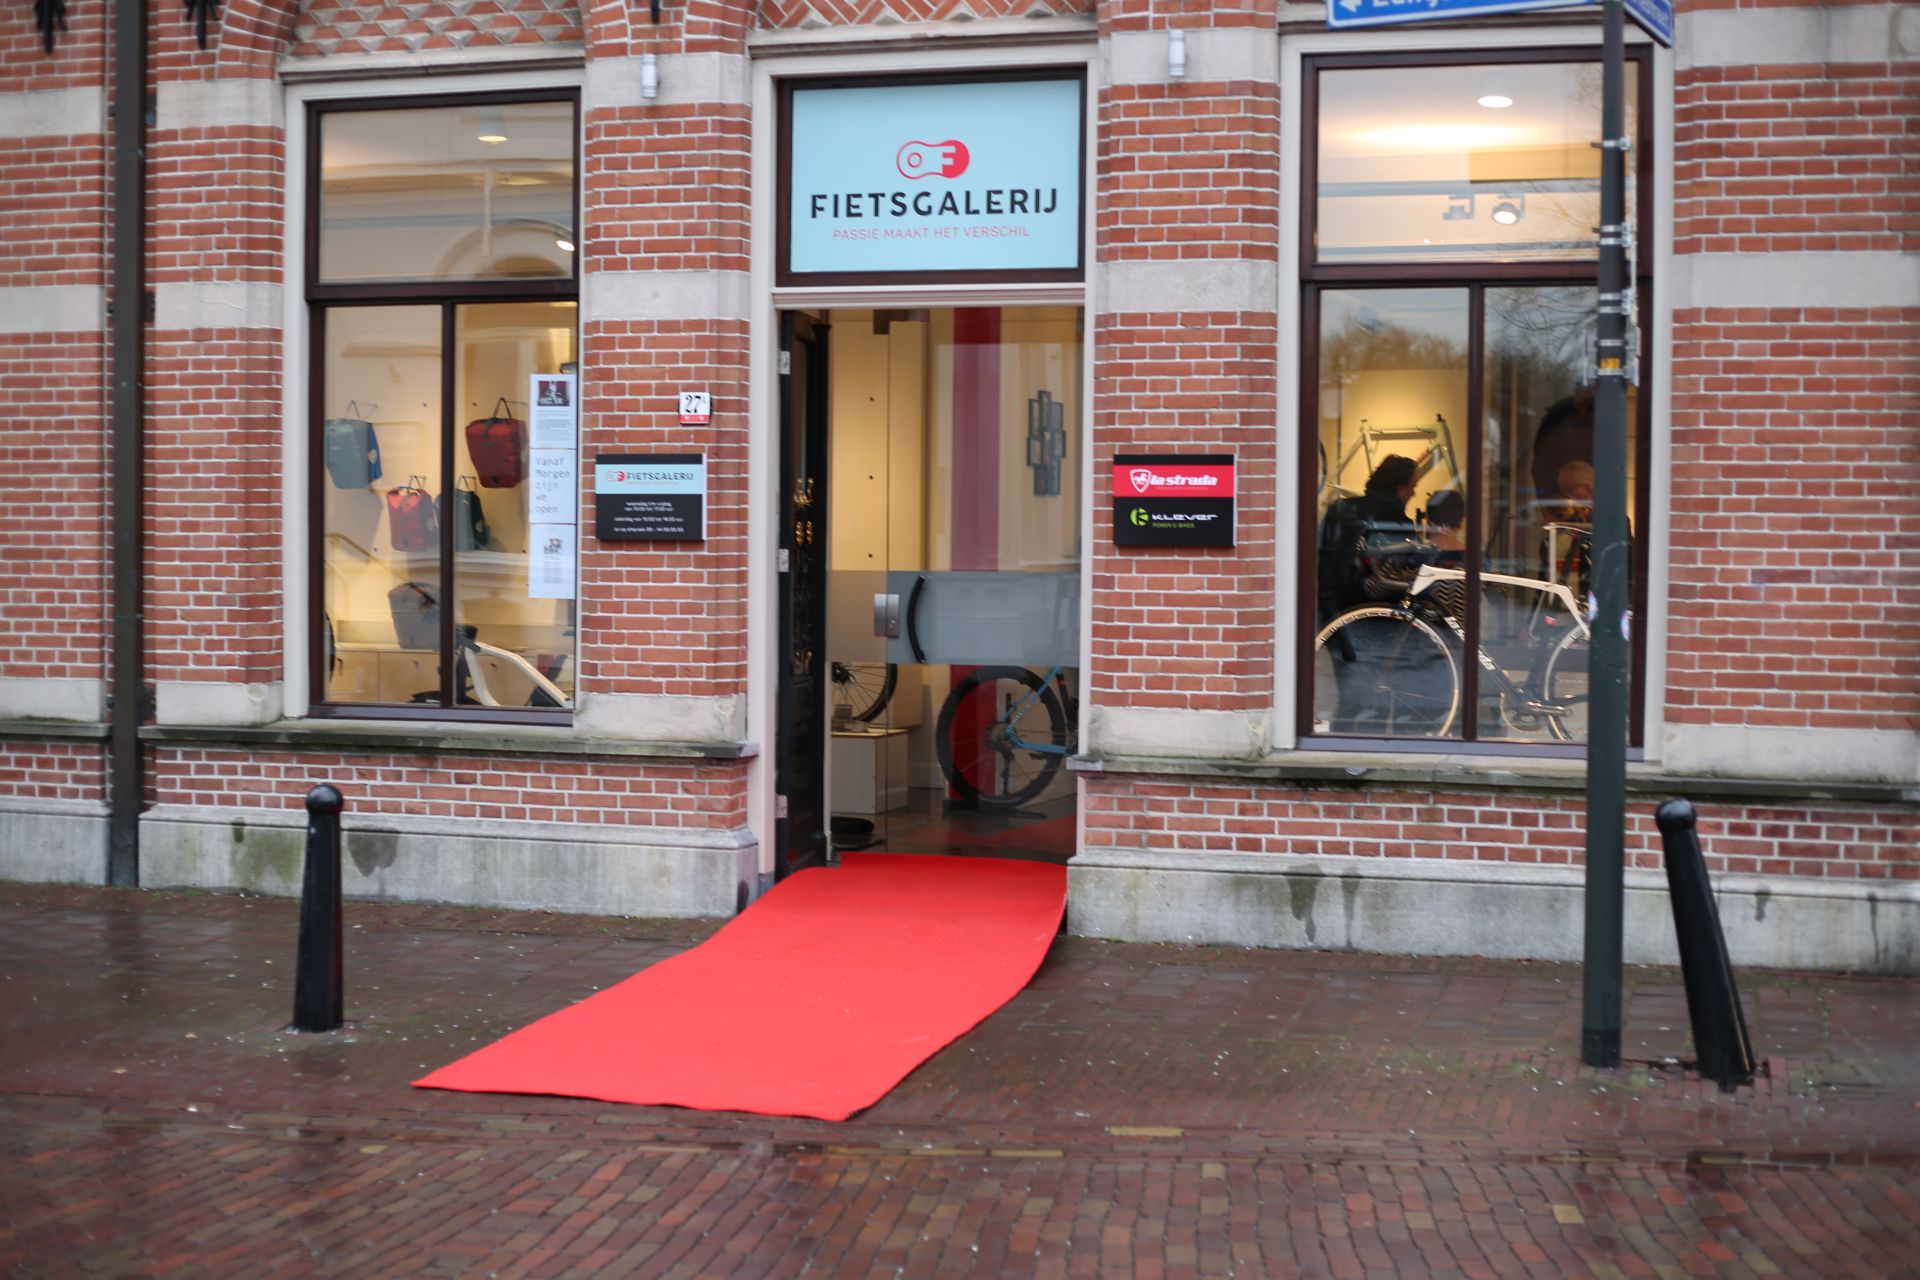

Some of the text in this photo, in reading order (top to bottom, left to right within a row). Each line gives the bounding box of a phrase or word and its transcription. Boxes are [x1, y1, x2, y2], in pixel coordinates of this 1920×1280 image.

[810, 188, 1057, 219] FIETSGALERIJ
[832, 226, 1030, 240] PASSIE MAAKT HET VERSCHIL
